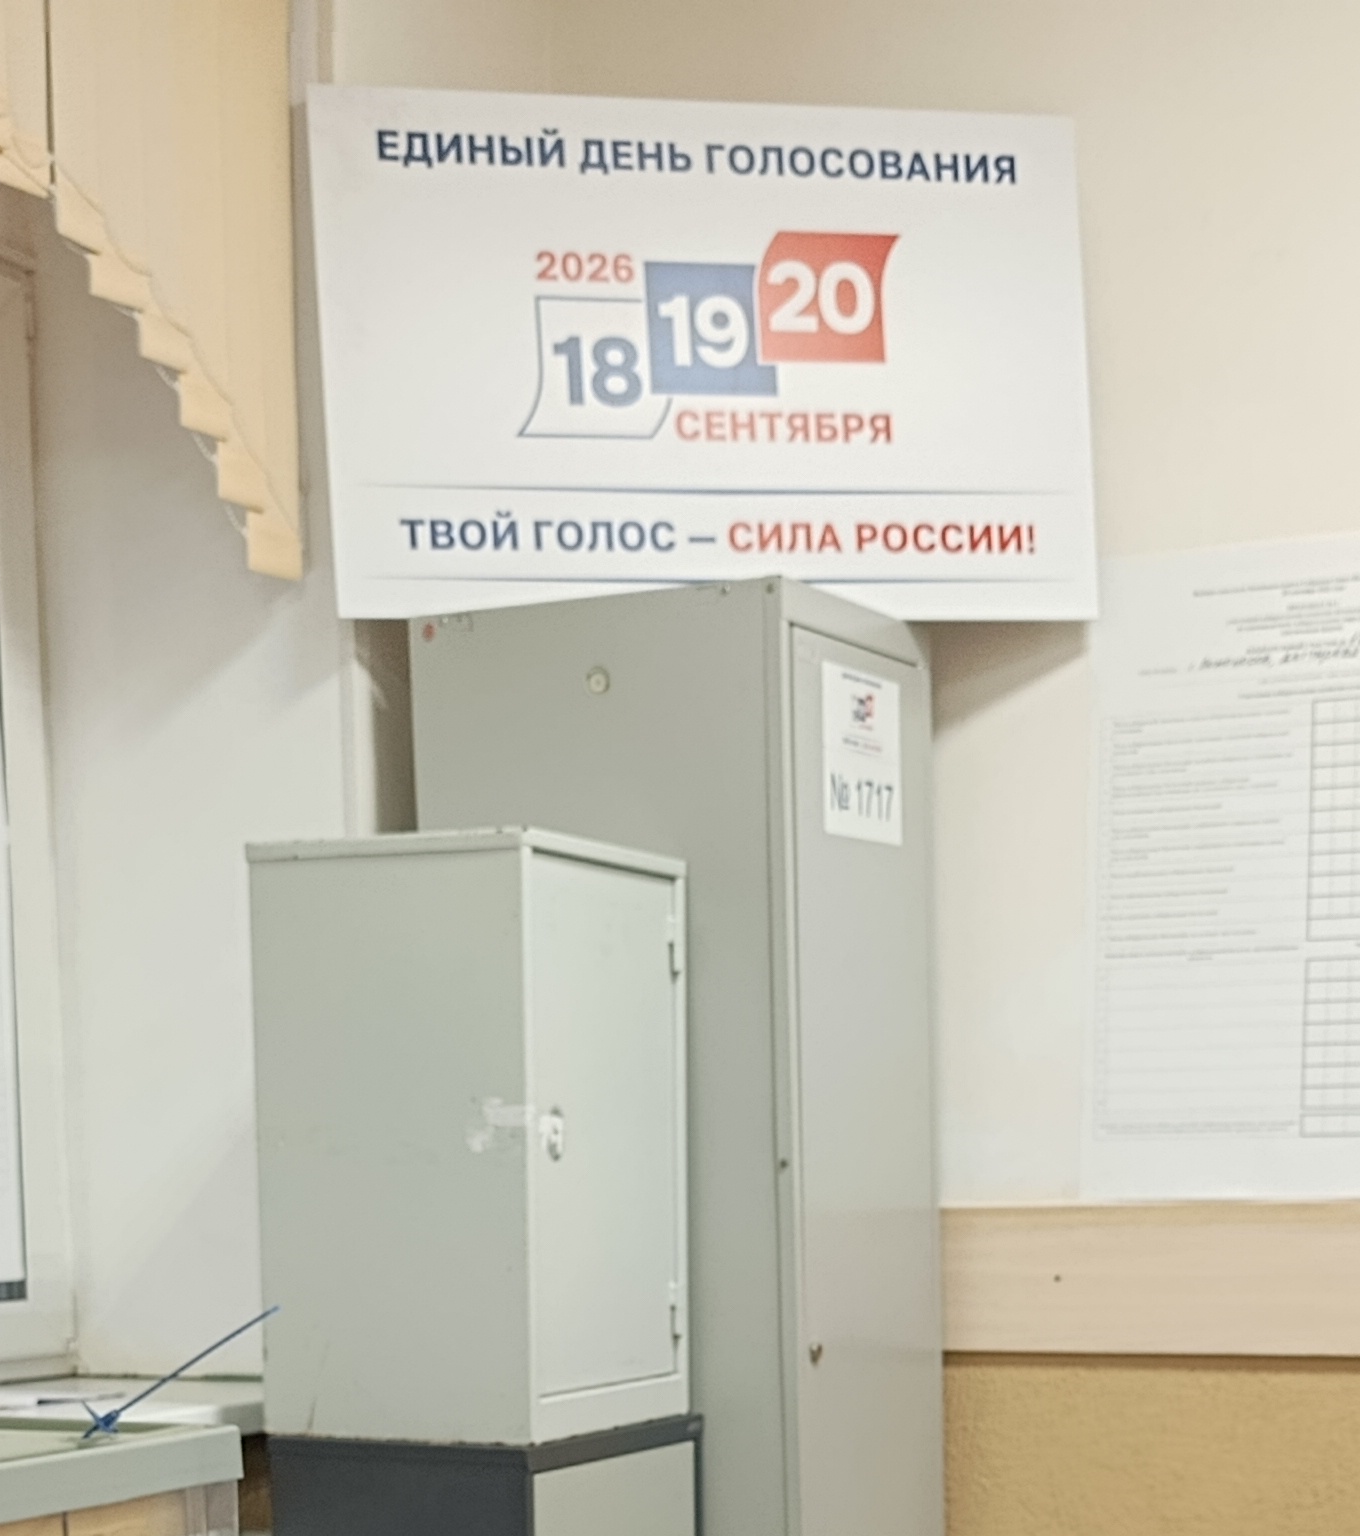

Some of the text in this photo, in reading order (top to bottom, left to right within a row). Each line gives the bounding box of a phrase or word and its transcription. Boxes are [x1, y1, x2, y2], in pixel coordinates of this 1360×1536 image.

[377, 126, 1018, 184] ЕДИНЫЙ ДЕНЬ ГОЛОСОВАНИЯ
[535, 250, 635, 284] 2026
[767, 260, 875, 335] 20
[658, 295, 750, 369] 19
[553, 335, 643, 407] 18
[676, 410, 894, 445] СЕНТЯБРЯ
[400, 514, 519, 553] ТВОЙ
[533, 520, 676, 553] ГОЛОС
[729, 522, 842, 554] СИЛА
[856, 524, 1036, 556] РОССИИ!
[830, 772, 895, 822] № 1717
